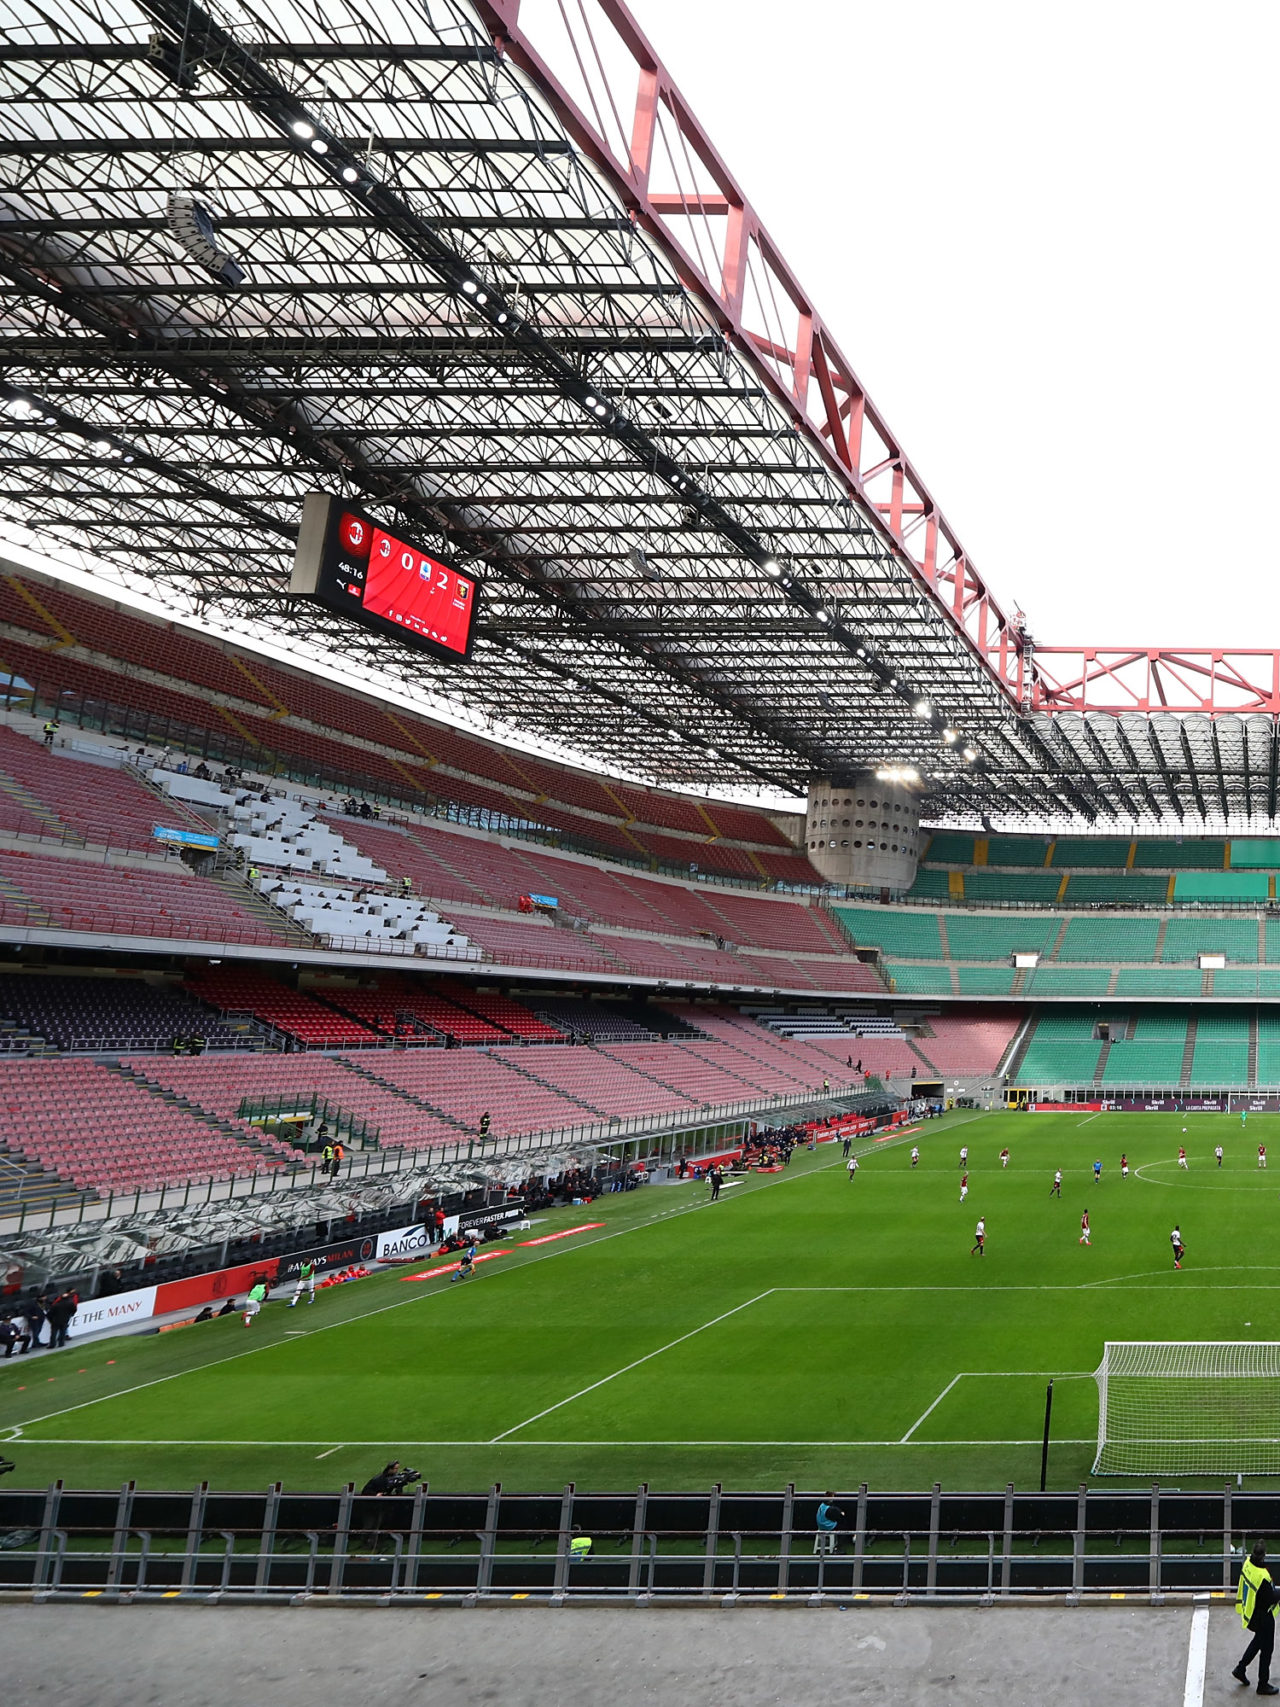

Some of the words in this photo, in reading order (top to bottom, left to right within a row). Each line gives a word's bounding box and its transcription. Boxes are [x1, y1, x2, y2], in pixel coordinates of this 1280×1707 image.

[338, 562, 364, 580] 48:16
[402, 552, 414, 570] 0
[437, 572, 448, 589] 2
[384, 1234, 427, 1256] BANCO
[83, 1310, 104, 1324] THE
[108, 1301, 142, 1317] MANY
